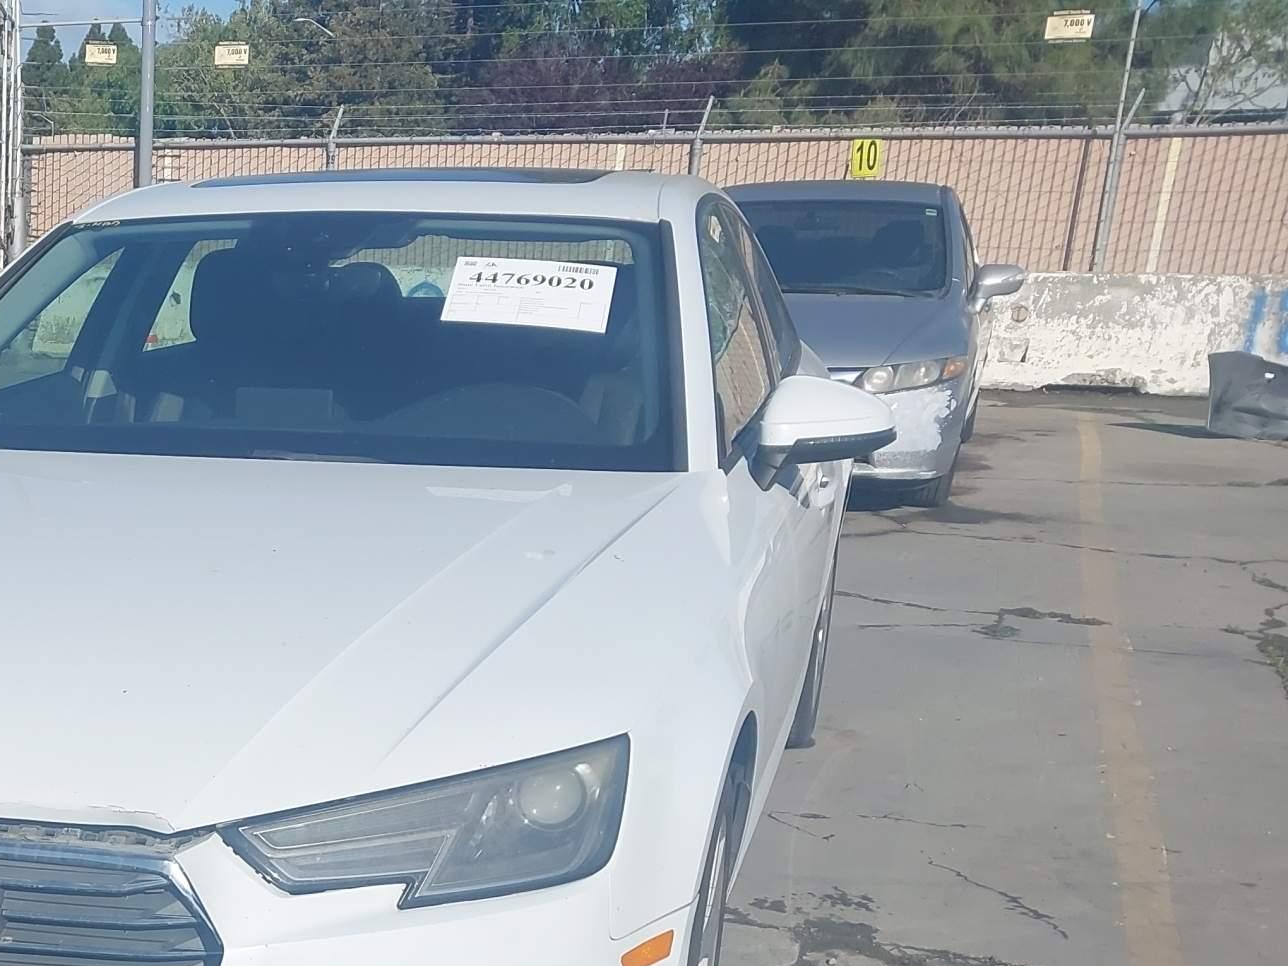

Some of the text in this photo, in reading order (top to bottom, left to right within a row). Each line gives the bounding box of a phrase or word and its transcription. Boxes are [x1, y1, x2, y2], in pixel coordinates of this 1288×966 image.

[1063, 18, 1085, 28] 7,000
[855, 140, 879, 172] 10
[469, 270, 595, 291] 44769020
